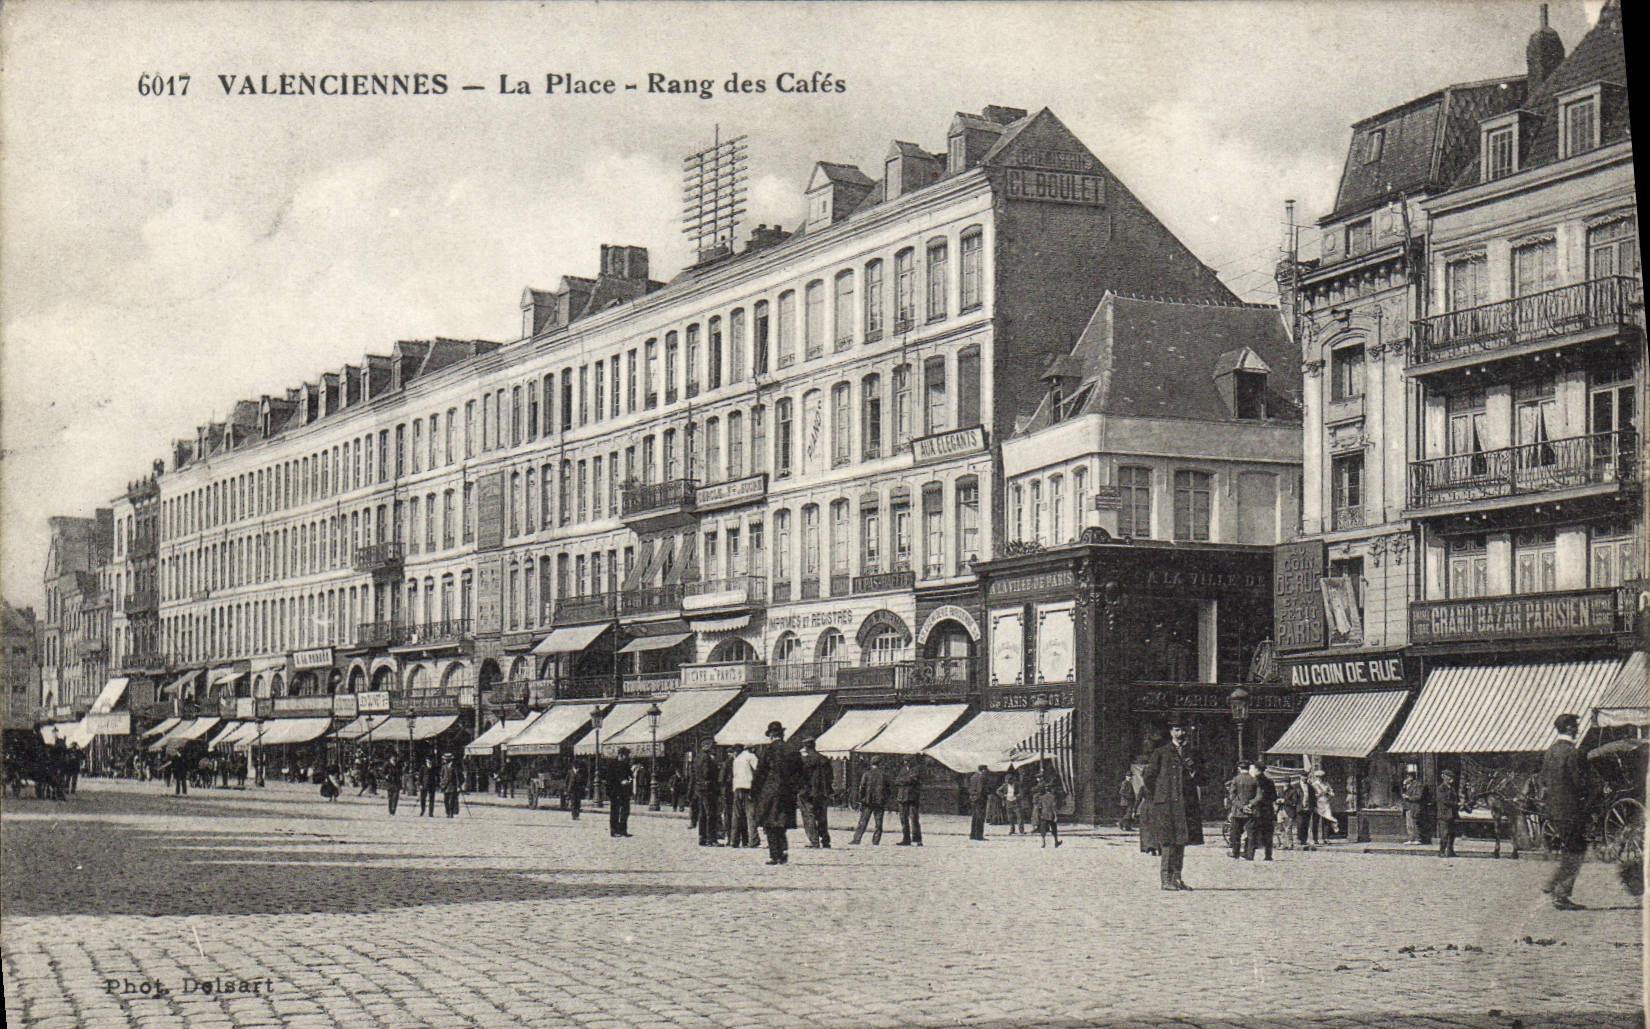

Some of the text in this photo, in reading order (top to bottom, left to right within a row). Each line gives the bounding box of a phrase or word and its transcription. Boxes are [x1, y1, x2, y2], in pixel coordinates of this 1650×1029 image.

[920, 439, 936, 458] AUX
[1285, 557, 1315, 571] COIN
[1046, 570, 1073, 588] PARIS
[1277, 571, 1322, 596] DE RUE
[1431, 604, 1473, 634] GRAND
[1477, 601, 1522, 633] BAZAR
[1525, 597, 1590, 631] PARISIEN
[1279, 620, 1322, 646] PARIS
[1291, 658, 1402, 687] AU COIN DE RUE
